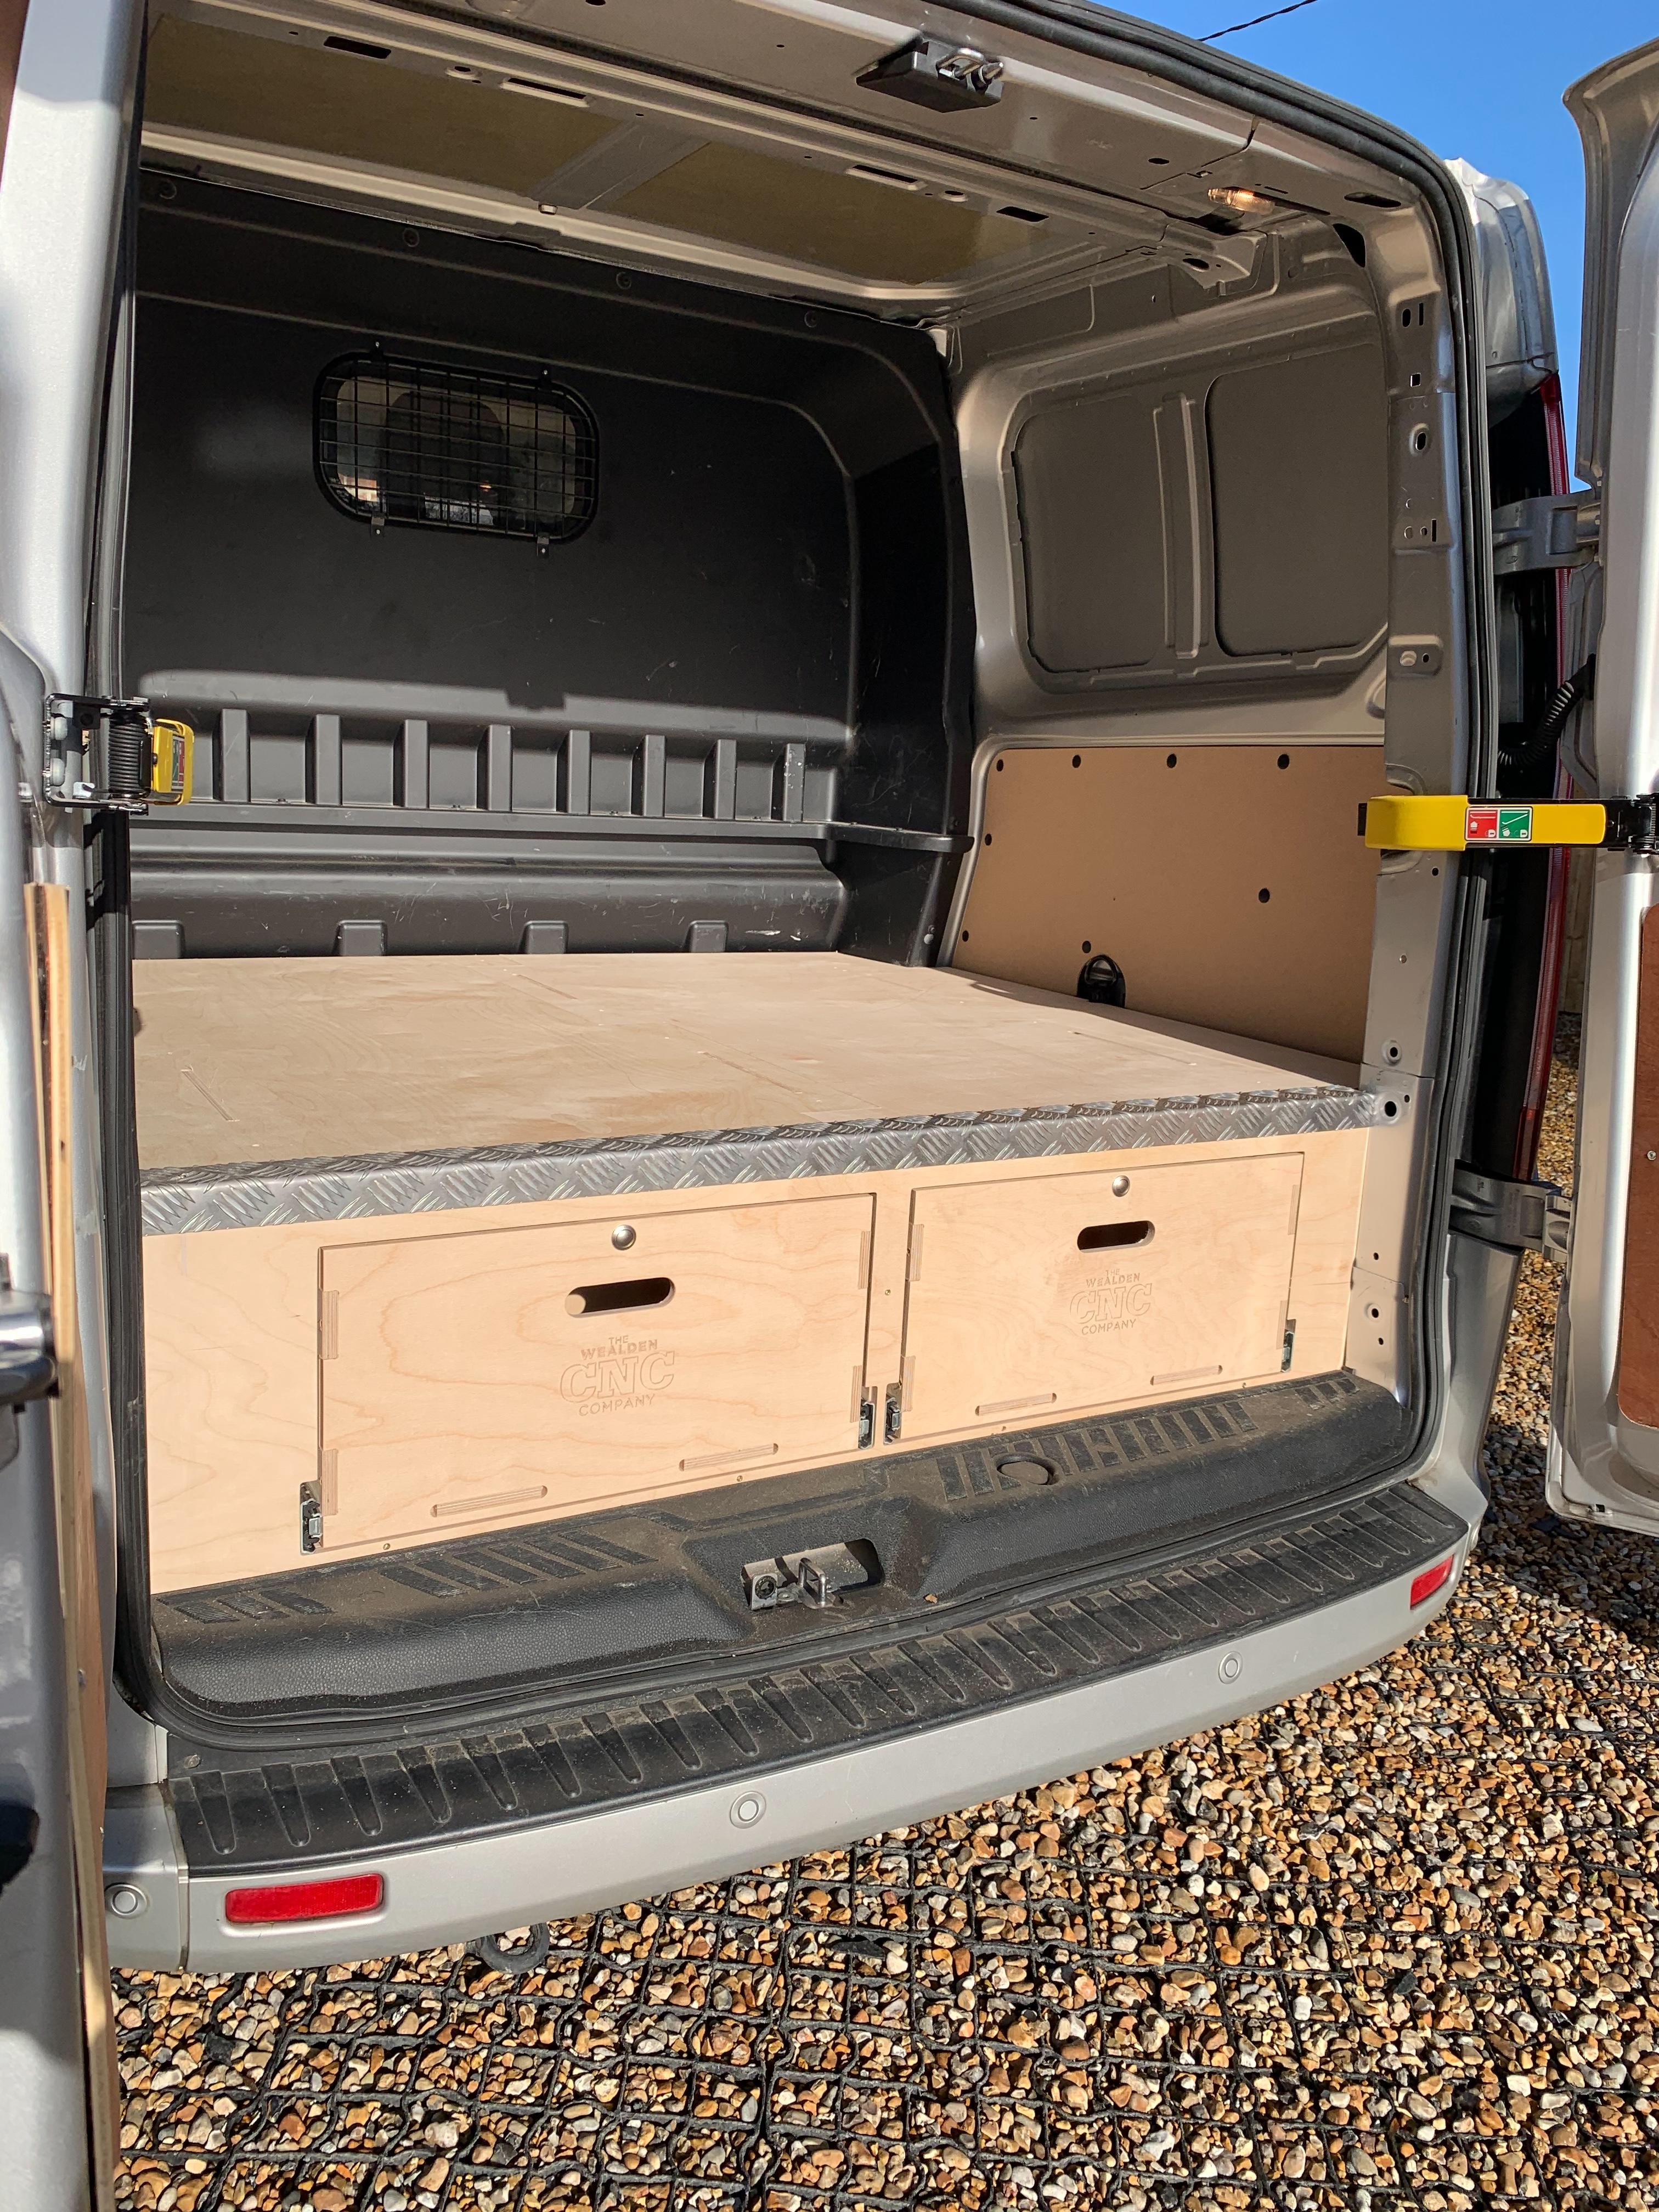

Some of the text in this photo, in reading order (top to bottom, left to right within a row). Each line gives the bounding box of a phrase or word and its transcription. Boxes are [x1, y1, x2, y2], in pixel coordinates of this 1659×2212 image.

[1086, 1273, 1141, 1288] WEALDEN
[1070, 1283, 1152, 1324] CNC
[1081, 1319, 1136, 1335] COMPANY
[580, 1339, 658, 1360] WEALDEN
[608, 1335, 629, 1345] THE
[560, 1351, 675, 1403] CNC
[579, 1394, 655, 1417] COMPANY
